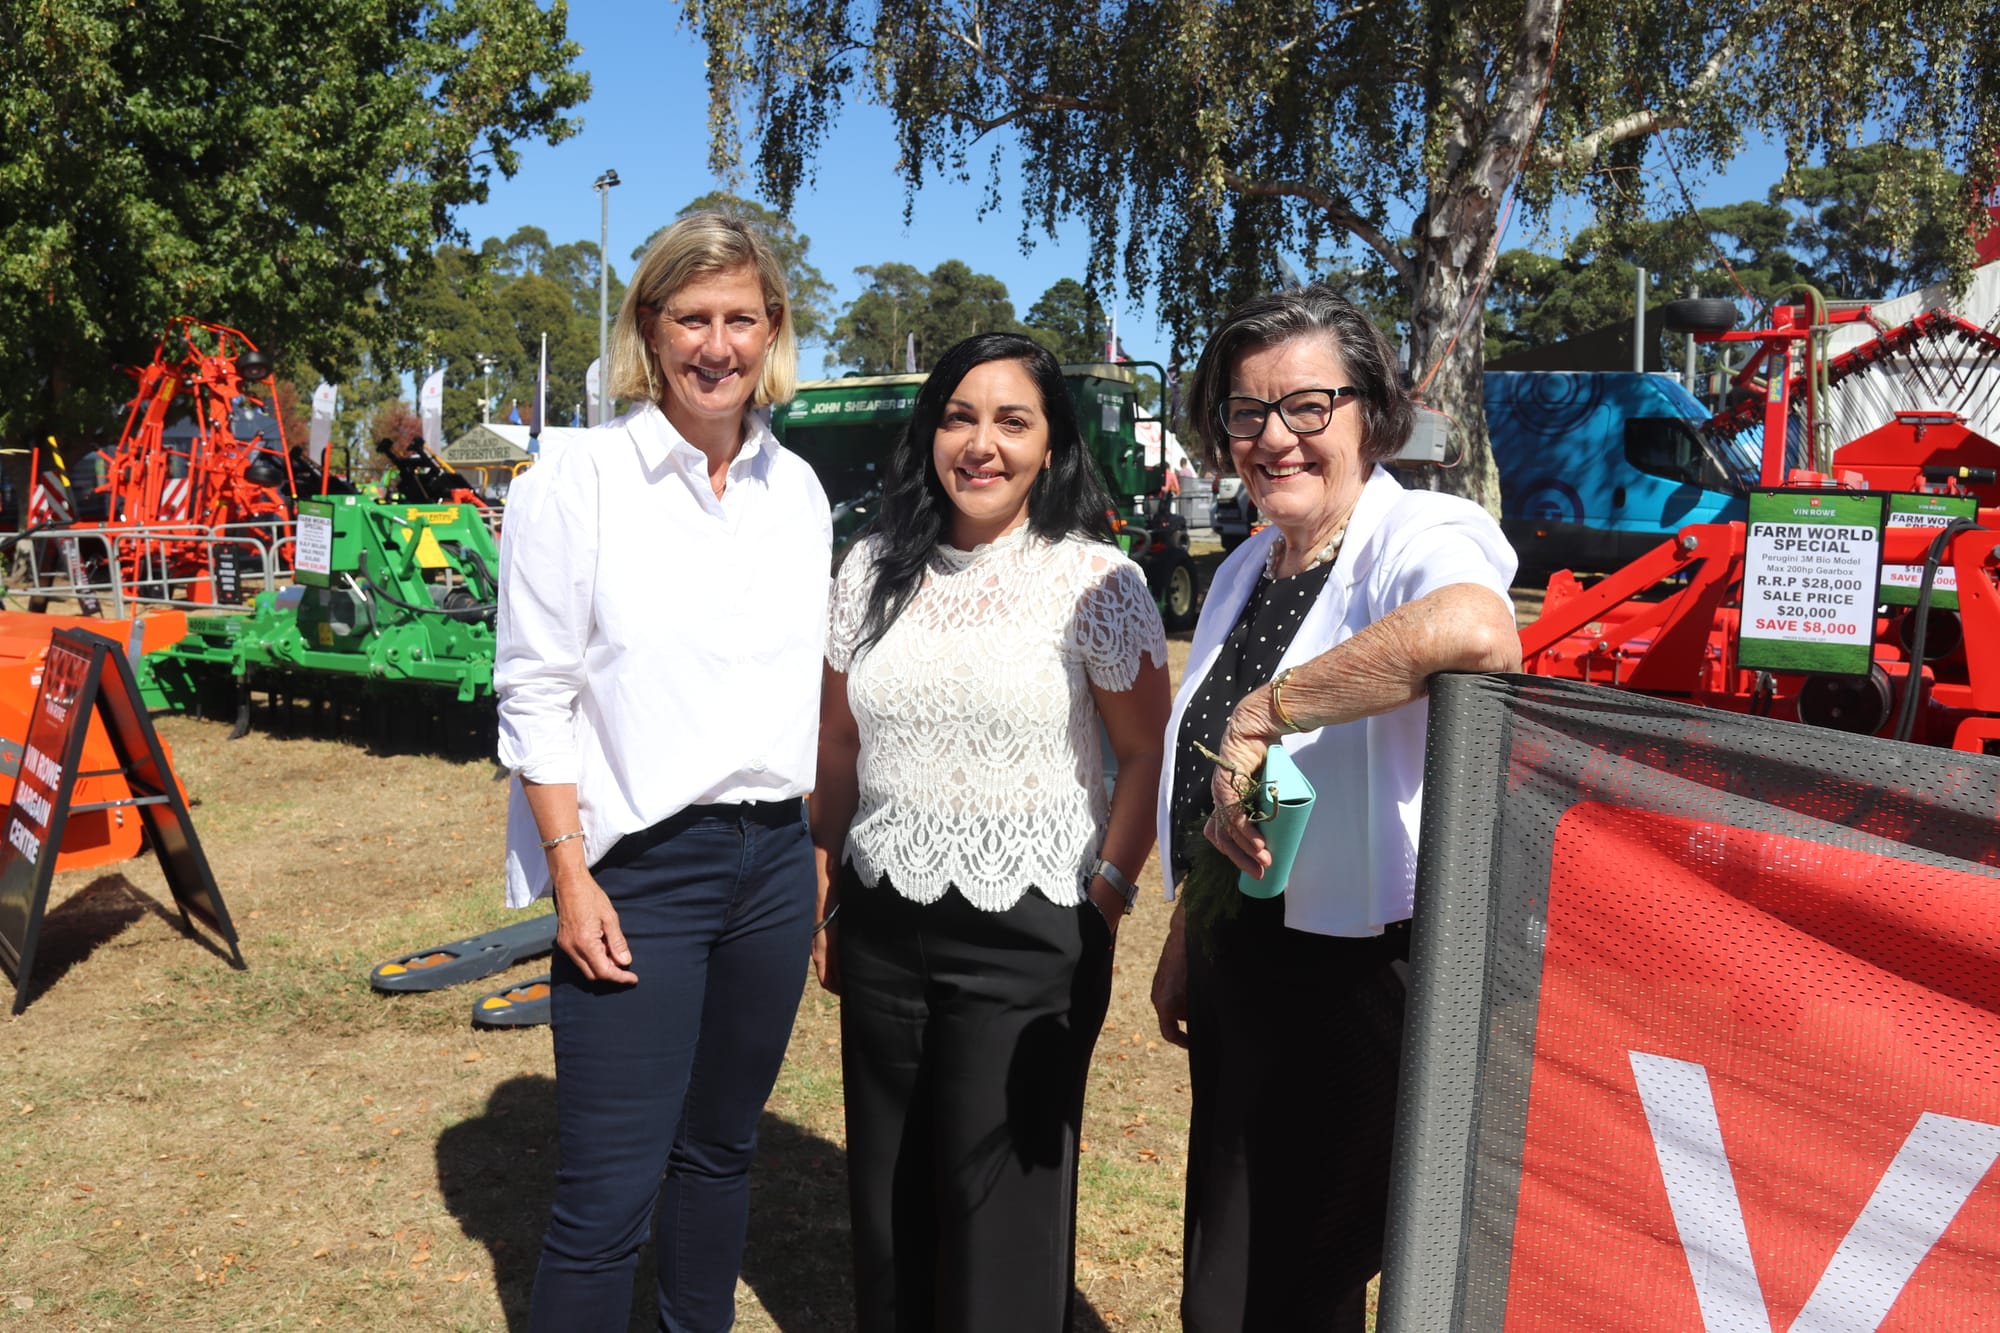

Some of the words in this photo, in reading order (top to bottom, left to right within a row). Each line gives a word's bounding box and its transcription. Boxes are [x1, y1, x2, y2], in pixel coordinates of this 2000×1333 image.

[811, 402, 841, 414] JOHN
[844, 400, 897, 412] SHEARER
[447, 447, 512, 461] SUPERSTORE
[1792, 508, 1809, 516] VIN
[1810, 509, 1837, 517] ROWE
[1892, 514, 1924, 524] FARM
[1927, 516, 1954, 526] WOR
[1754, 525, 1802, 539] FARM
[1808, 527, 1873, 542] WORLD
[1773, 539, 1850, 554] SPECIAL
[1762, 553, 1798, 564] Perugini
[1800, 555, 1813, 564] 3M
[1816, 556, 1831, 565] Bio
[1833, 556, 1861, 565] Model
[1766, 564, 1785, 573] Max
[1787, 565, 1813, 575] 200hp
[1816, 566, 1854, 576] Gearbox
[1757, 575, 1797, 587] R.R.P
[1801, 577, 1862, 591] $28,000
[1890, 573, 1918, 582] SAVE
[1762, 590, 1802, 602] SALE
[1807, 592, 1854, 605] PRICE
[1777, 605, 1837, 619] $20,000
[1755, 618, 1798, 632] SAVE
[1803, 620, 1857, 636] $8,000
[24, 743, 41, 774] VIN
[36, 751, 63, 792] ROWE
[15, 780, 52, 828] BARGAIN
[9, 818, 40, 865] CENTRE
